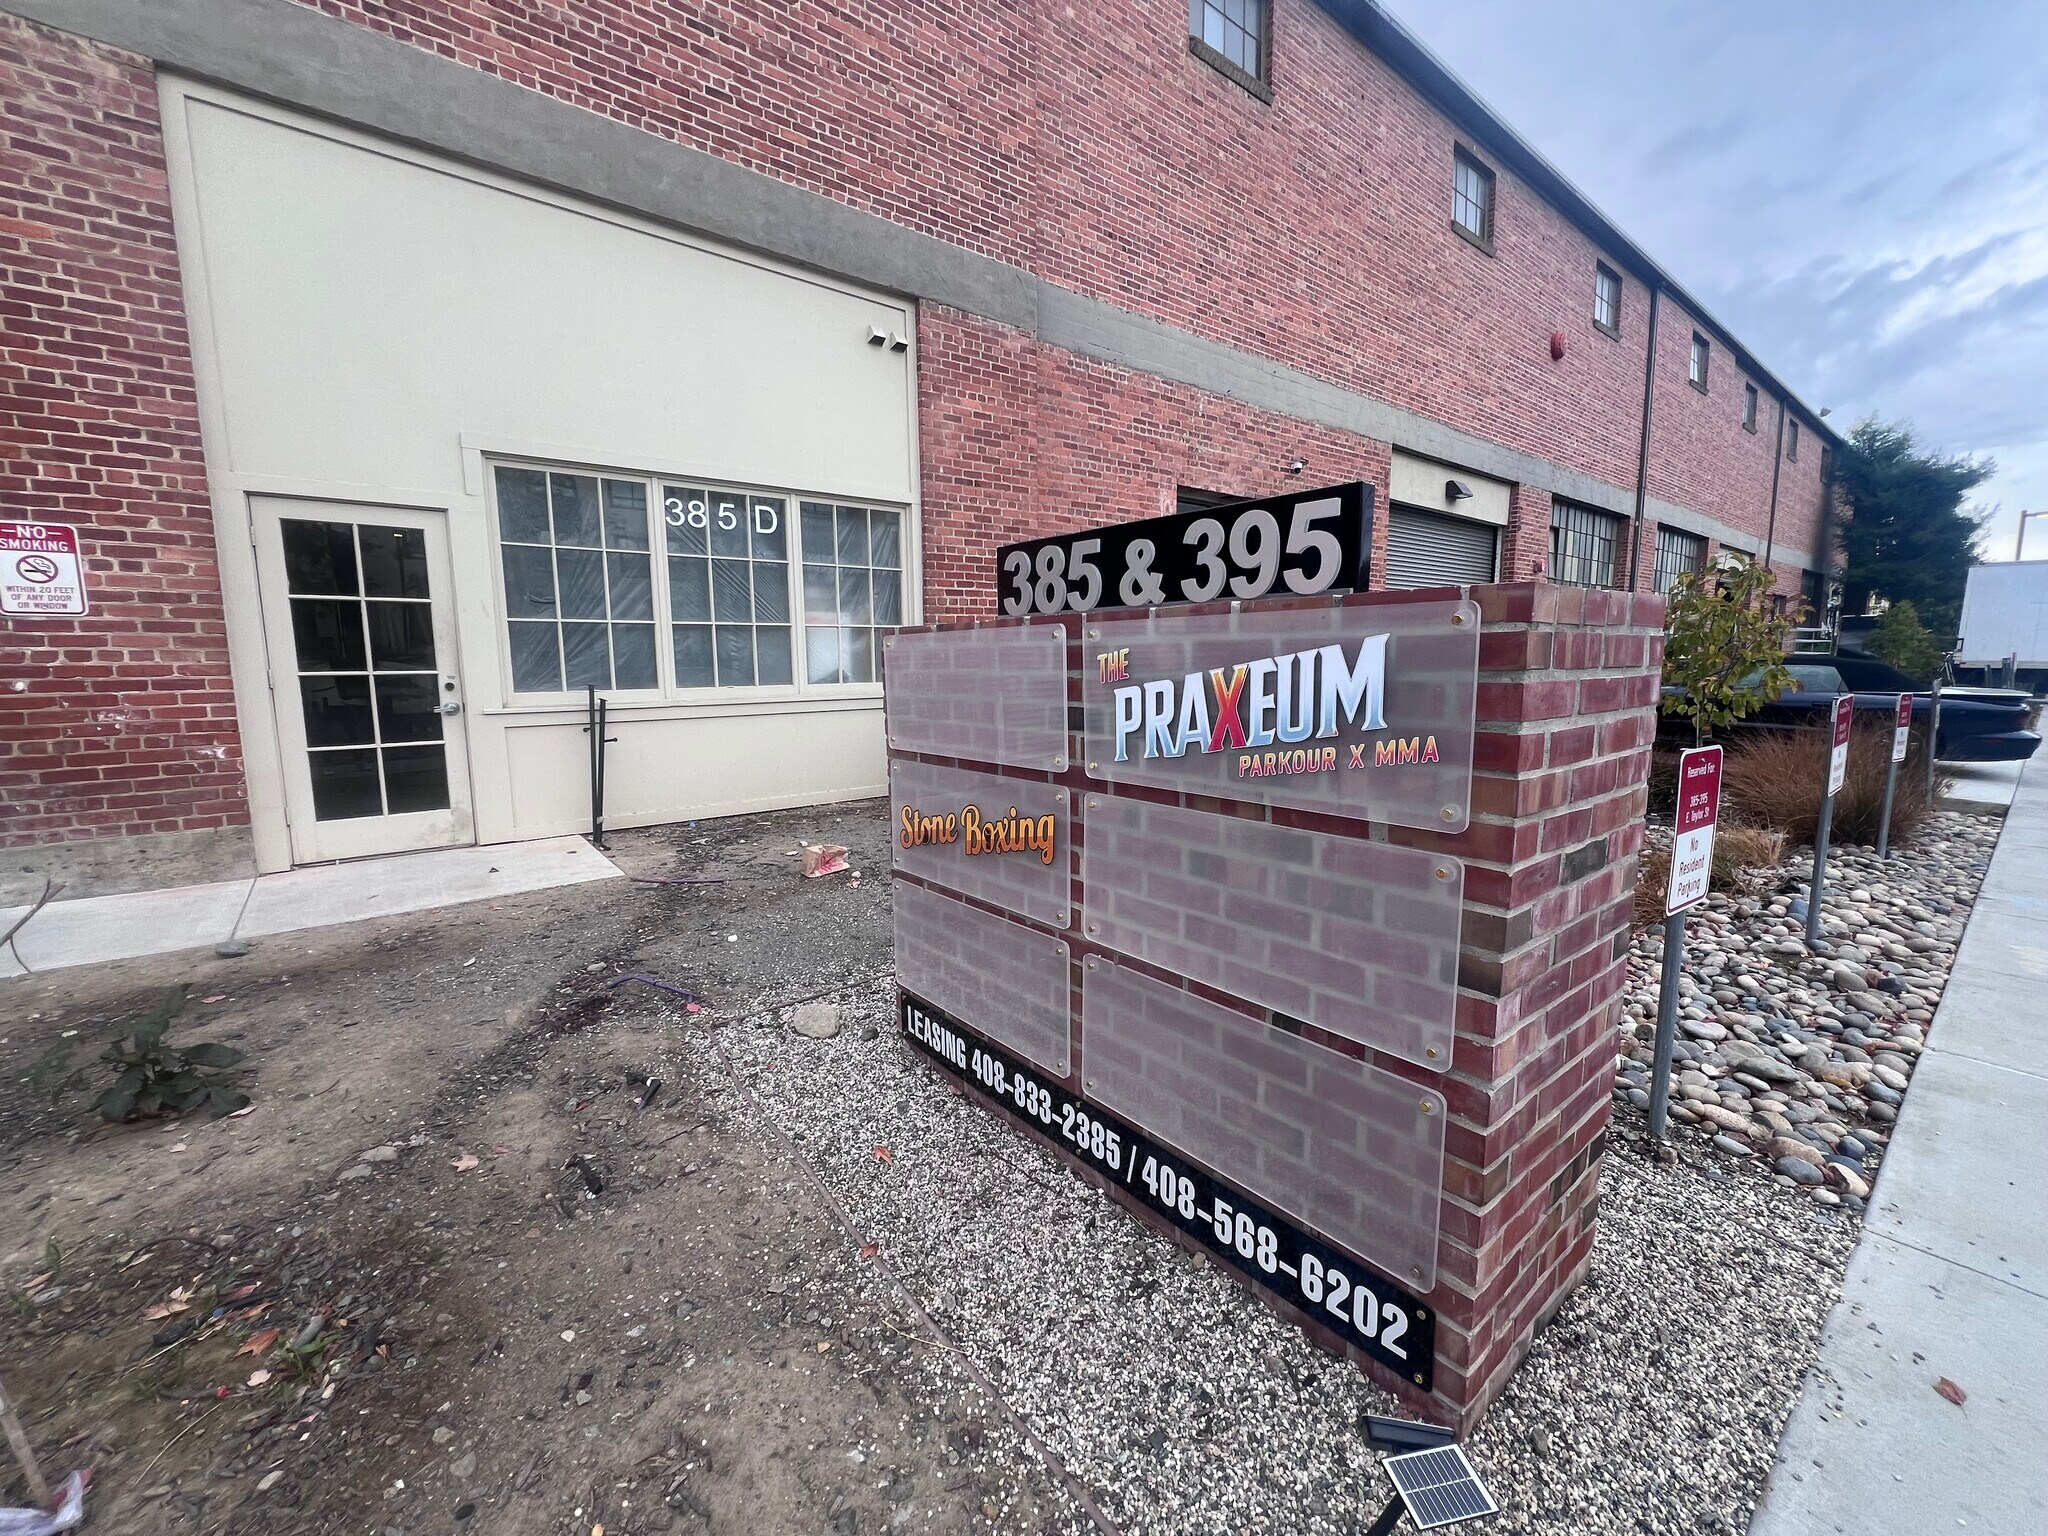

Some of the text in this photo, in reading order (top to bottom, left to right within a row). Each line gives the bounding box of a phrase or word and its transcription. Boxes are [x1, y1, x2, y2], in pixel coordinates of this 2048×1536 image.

[754, 505, 778, 534] D
[16, 525, 46, 539] NO
[0, 538, 68, 552] SMOKING
[1003, 497, 1343, 617] 385 & 395
[6, 586, 36, 594] WITHIN
[39, 586, 52, 594] 20
[33, 602, 68, 610] WINDOW
[1097, 648, 1130, 684] THE
[1113, 633, 1391, 762] PRAXEUM
[1239, 736, 1440, 778] PARKOUR X MMA
[1687, 764, 1707, 778] Reserved
[900, 804, 1055, 865] Stone Boxing
[1690, 837, 1699, 852] No
[1679, 854, 1705, 877] Resident
[1677, 878, 1701, 898] Parking
[906, 1004, 967, 1070] LEASING
[972, 1049, 1121, 1170] 408-833-2385
[1142, 1156, 1408, 1360] 408-568-6202
